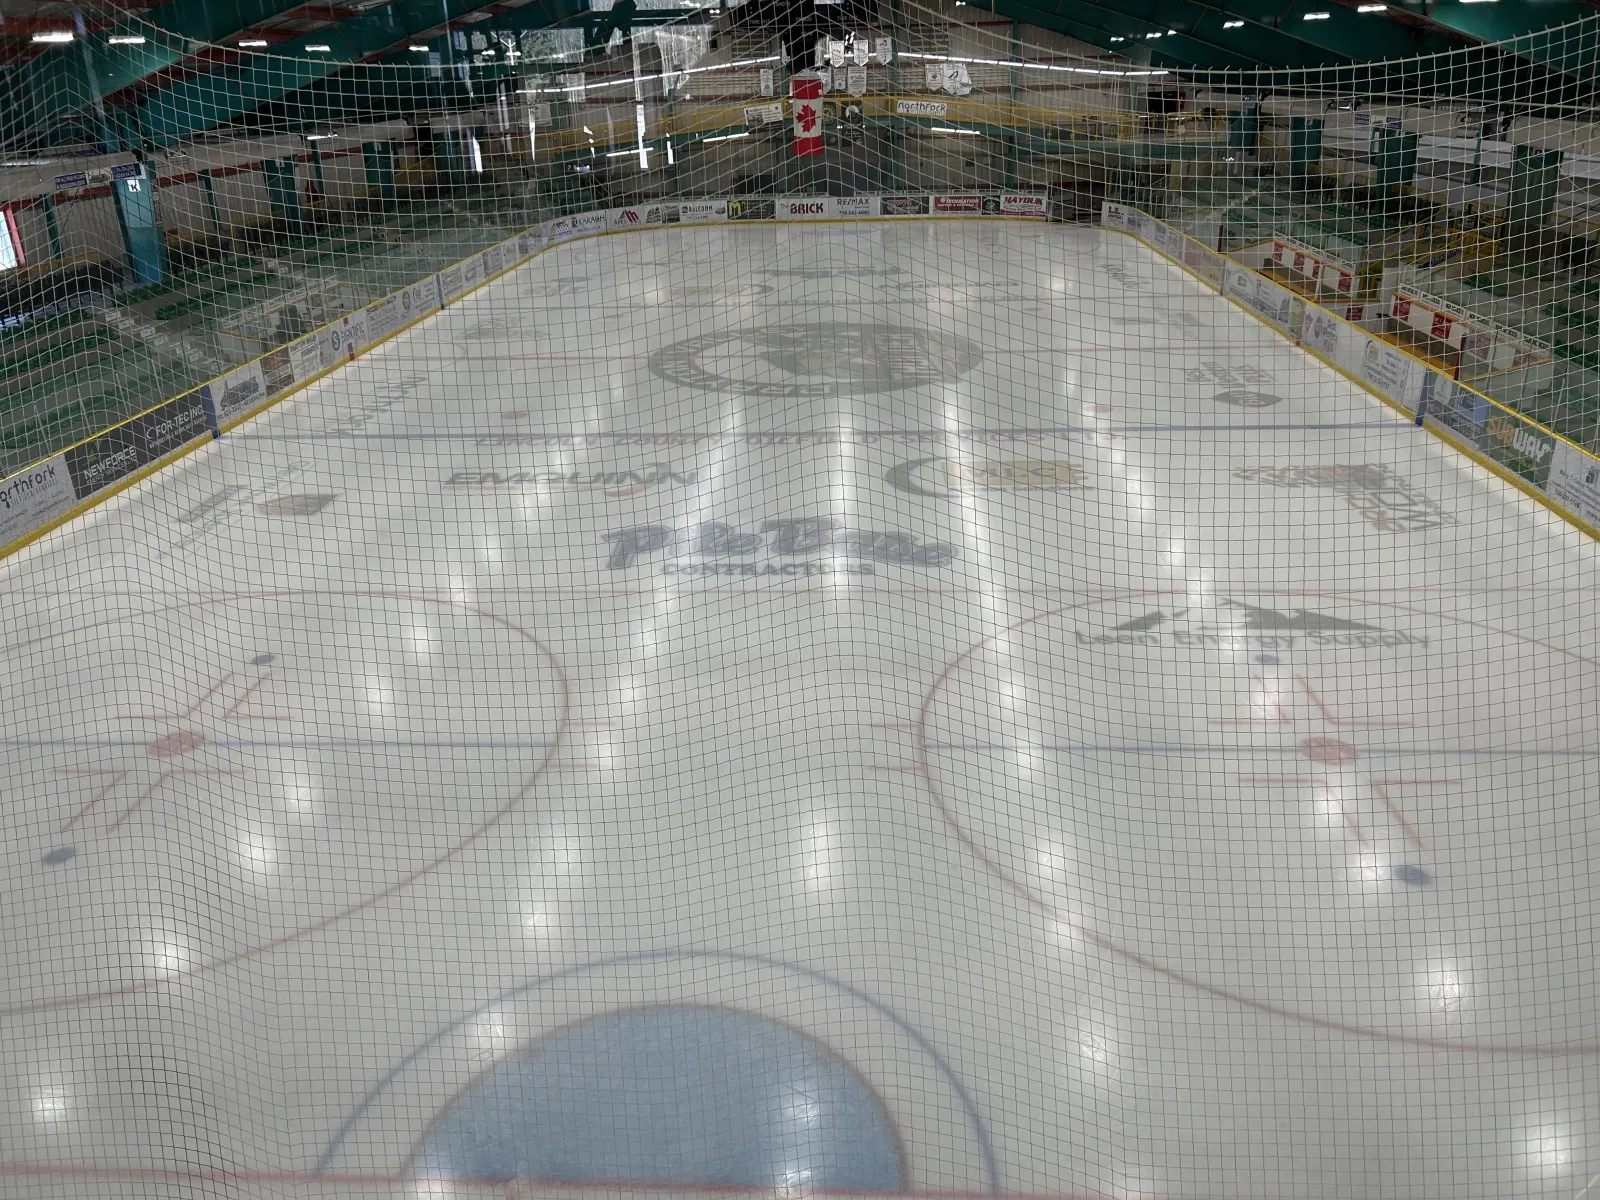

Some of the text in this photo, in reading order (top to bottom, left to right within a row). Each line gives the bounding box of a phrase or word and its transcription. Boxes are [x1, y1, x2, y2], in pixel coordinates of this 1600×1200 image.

[898, 101, 946, 112] northfork
[790, 203, 824, 214] BRICK
[837, 198, 869, 206] RE/MAX
[156, 411, 189, 437] FOR-TEC
[1487, 415, 1550, 462] SUBWAY
[83, 446, 136, 480] NEWFORCE
[0, 464, 56, 504] orthfork
[445, 471, 699, 486] EMQUINN
[663, 563, 876, 576] CONTRACTORS
[1307, 630, 1432, 649] Supply
